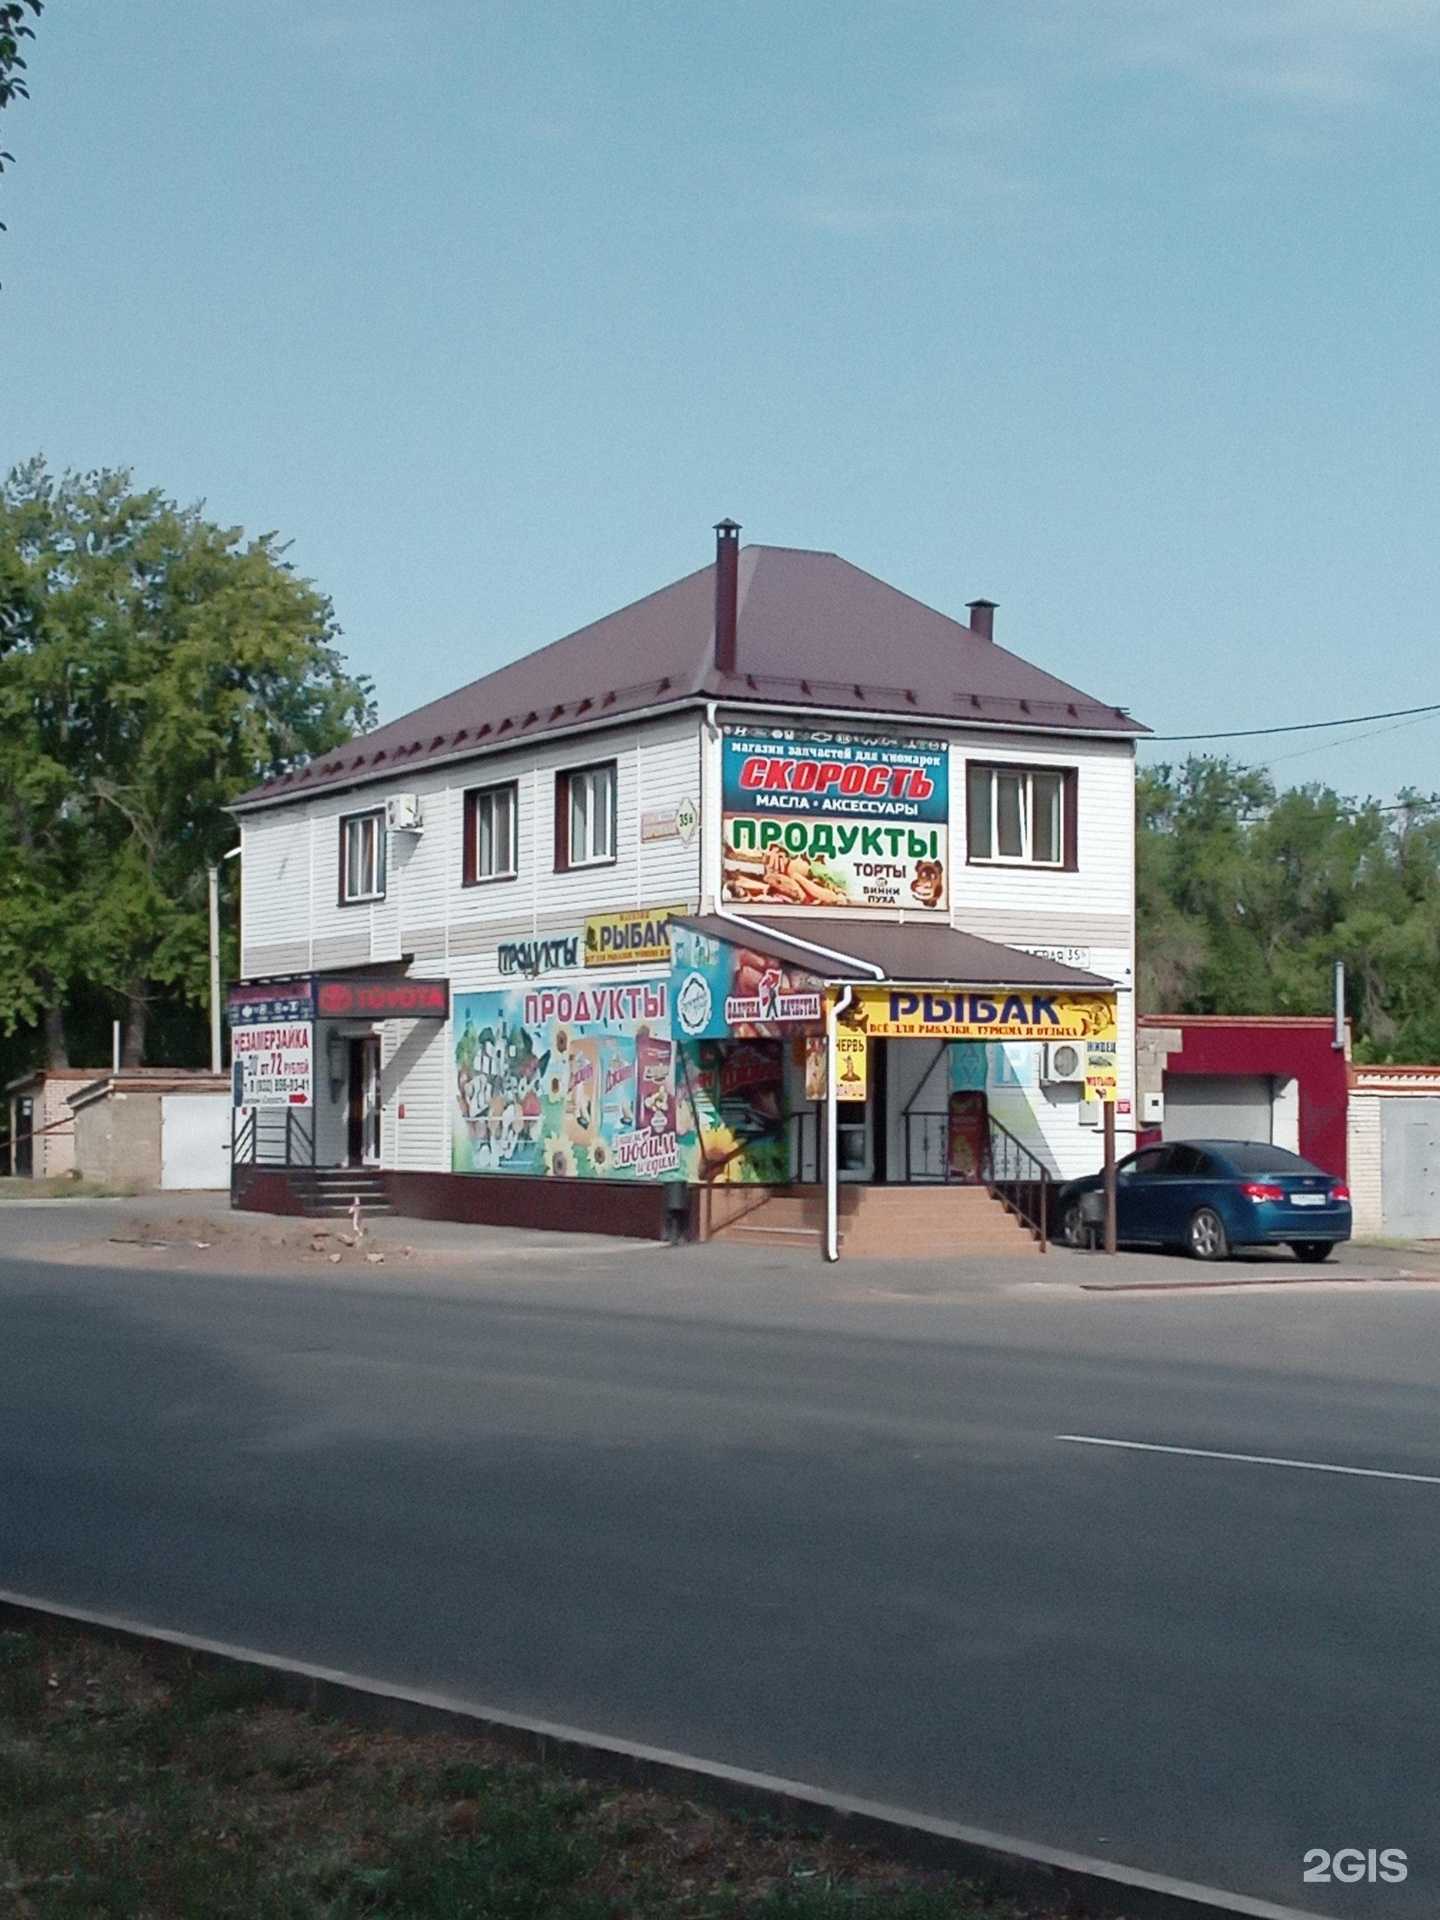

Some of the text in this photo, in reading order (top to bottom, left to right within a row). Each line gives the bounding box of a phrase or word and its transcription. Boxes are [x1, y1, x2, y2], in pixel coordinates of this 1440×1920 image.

[731, 742, 784, 756] магазин
[788, 746, 851, 760] запчастей
[855, 751, 878, 762] для
[739, 756, 934, 800] СКОРОСТЬ
[756, 795, 919, 815] МАСЛА АКСЕССУАРЫ
[731, 819, 939, 860] ПРОДУКТЫ
[853, 863, 906, 878] ТОРТЫ
[600, 920, 670, 951] РЫБАК
[498, 937, 578, 973] ПРОДУКТЫ
[524, 985, 667, 1024] ПРОДУКТЫ
[889, 992, 1061, 1025] РЫБАК
